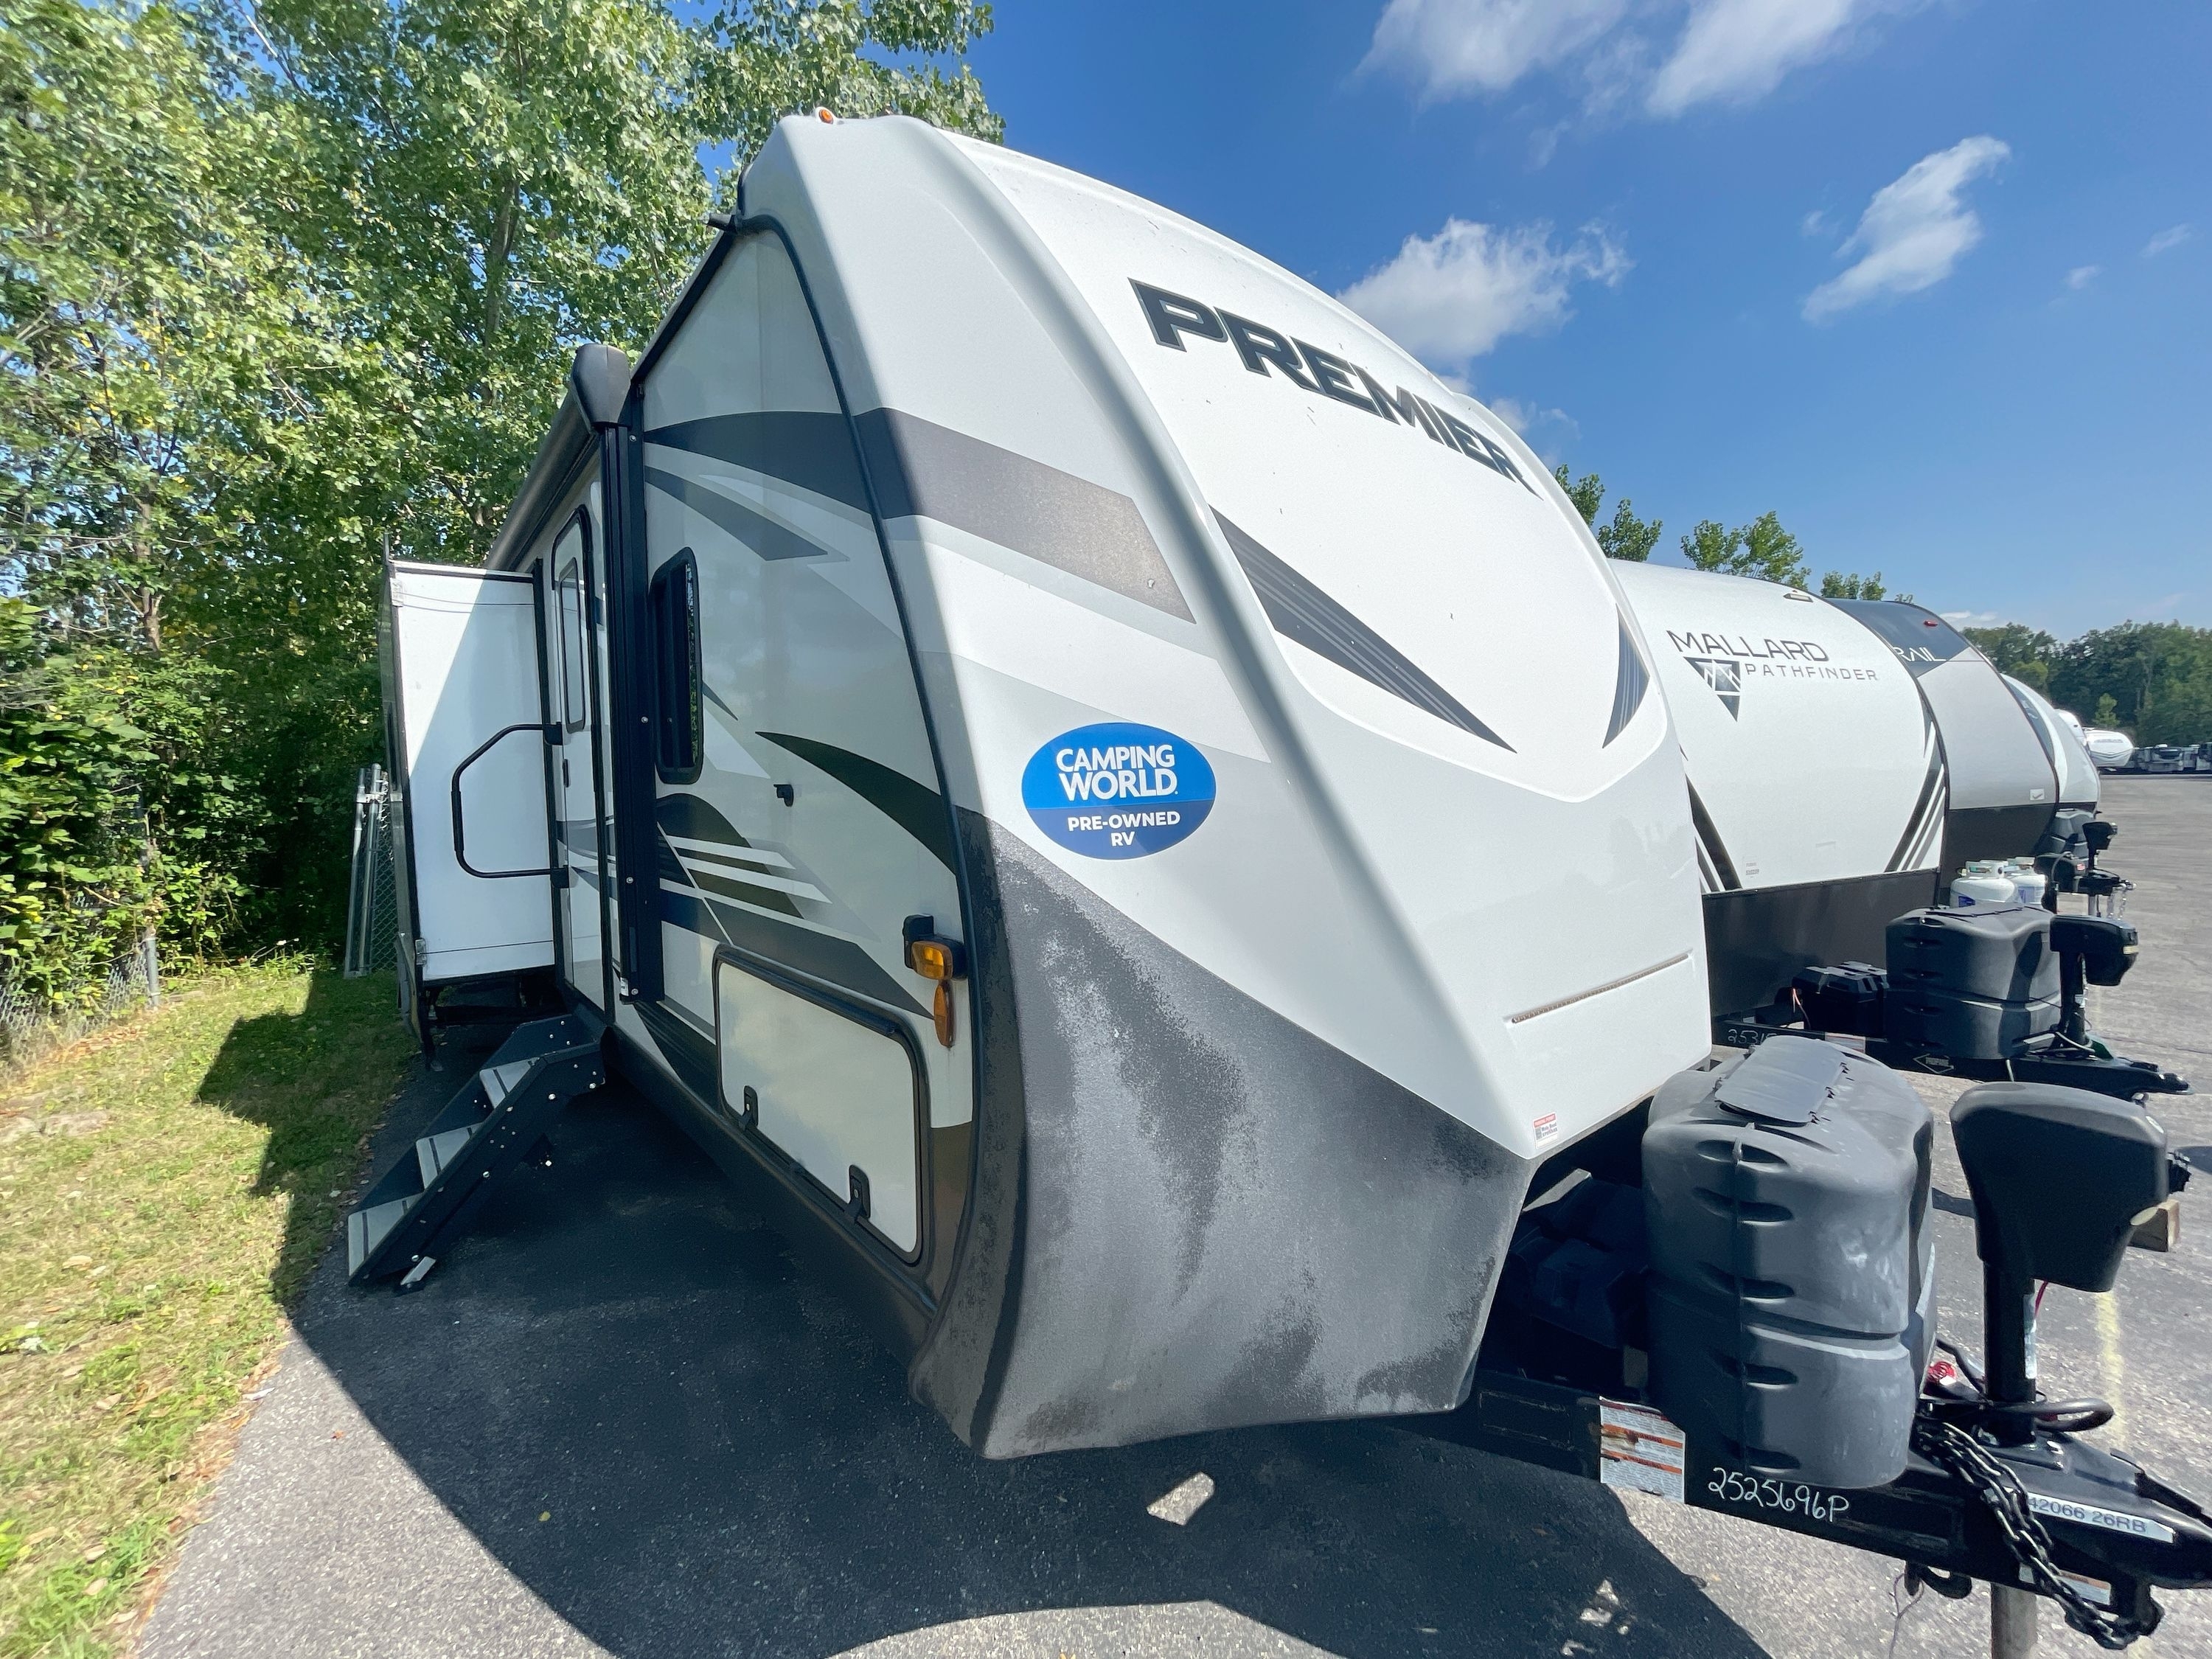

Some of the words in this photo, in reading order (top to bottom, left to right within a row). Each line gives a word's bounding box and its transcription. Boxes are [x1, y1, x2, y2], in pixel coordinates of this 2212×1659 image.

[1127, 277, 1544, 501] PREMIER
[1666, 630, 1829, 662] MALLARD
[1747, 664, 1878, 681] PATHFINDER
[1056, 745, 1175, 772] CAMPING
[1068, 811, 1180, 831] PRE-OWNED
[1111, 832, 1135, 846] RV
[1708, 1467, 1849, 1522] 2525696P
[2092, 1511, 2146, 1532] 26RB
